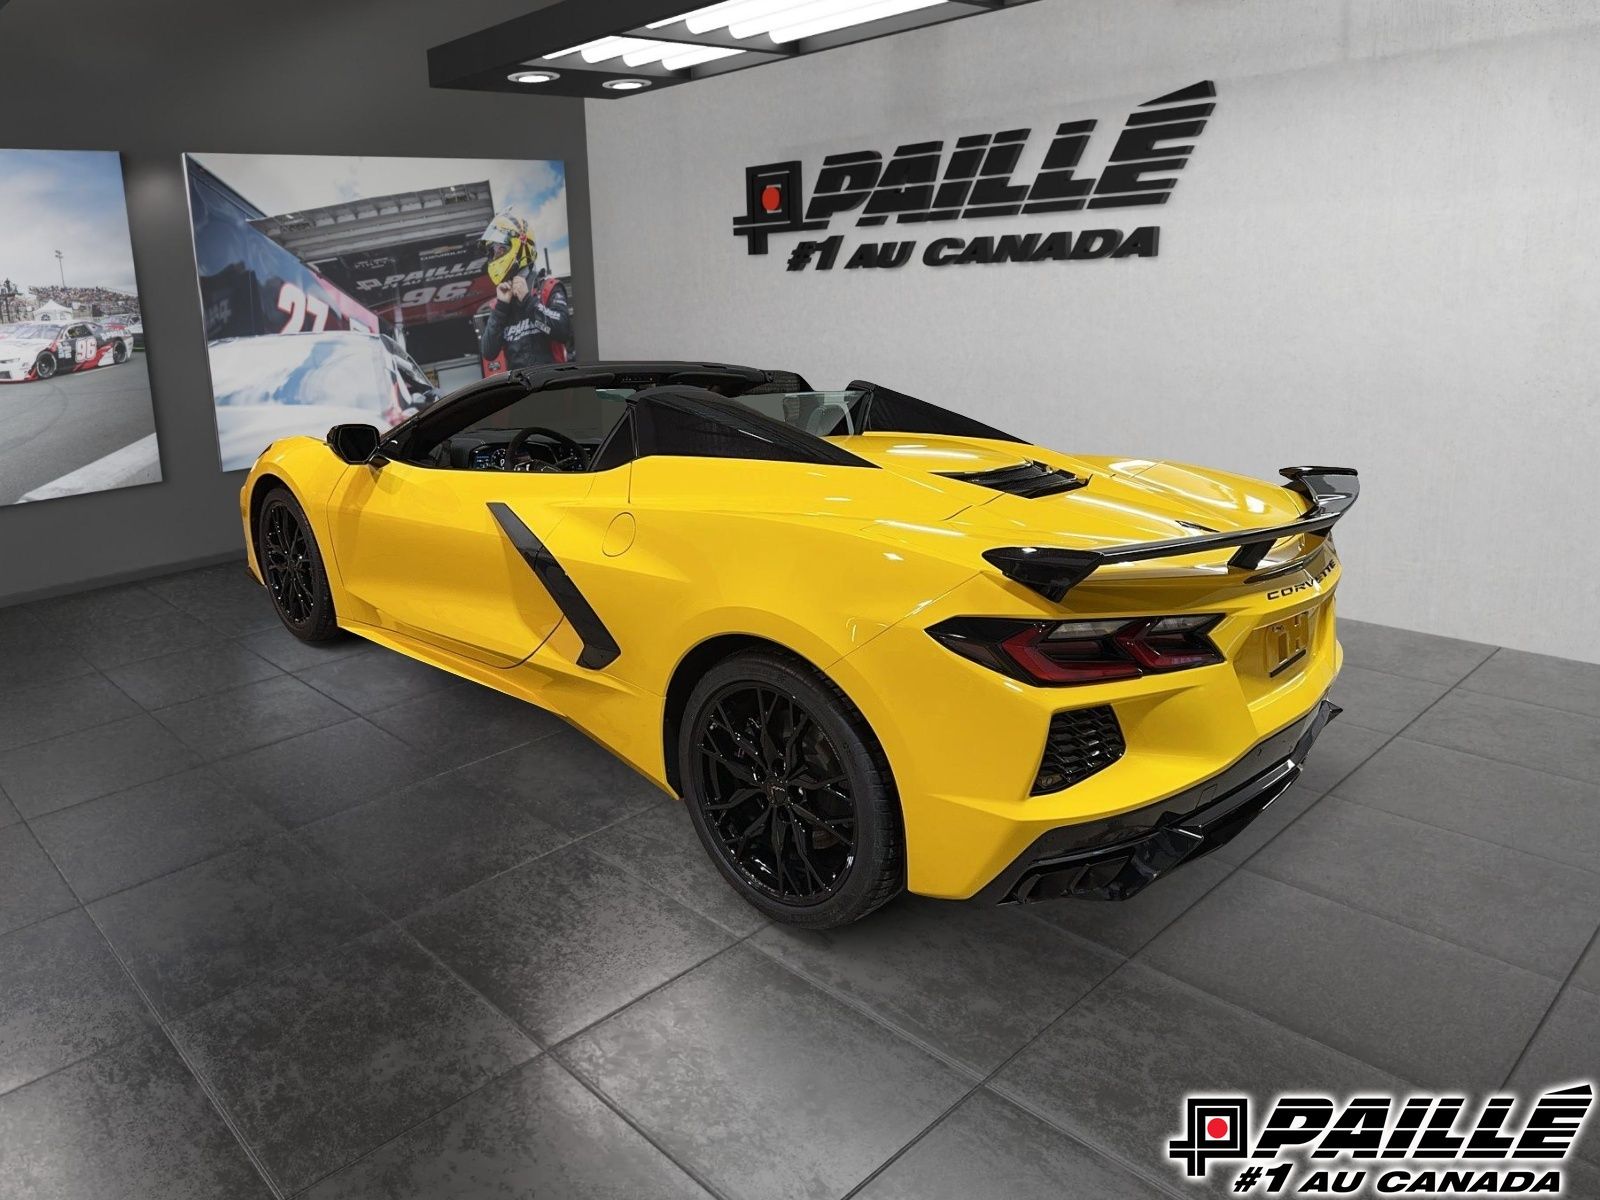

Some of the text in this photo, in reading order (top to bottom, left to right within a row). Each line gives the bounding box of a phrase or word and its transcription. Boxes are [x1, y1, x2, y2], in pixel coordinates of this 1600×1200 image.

[805, 80, 1216, 227] PAILLÉ
[787, 226, 1160, 271] #1 AU CANADA
[401, 280, 472, 308] 96
[75, 337, 97, 363] 96
[1267, 559, 1336, 600] CORVETTE
